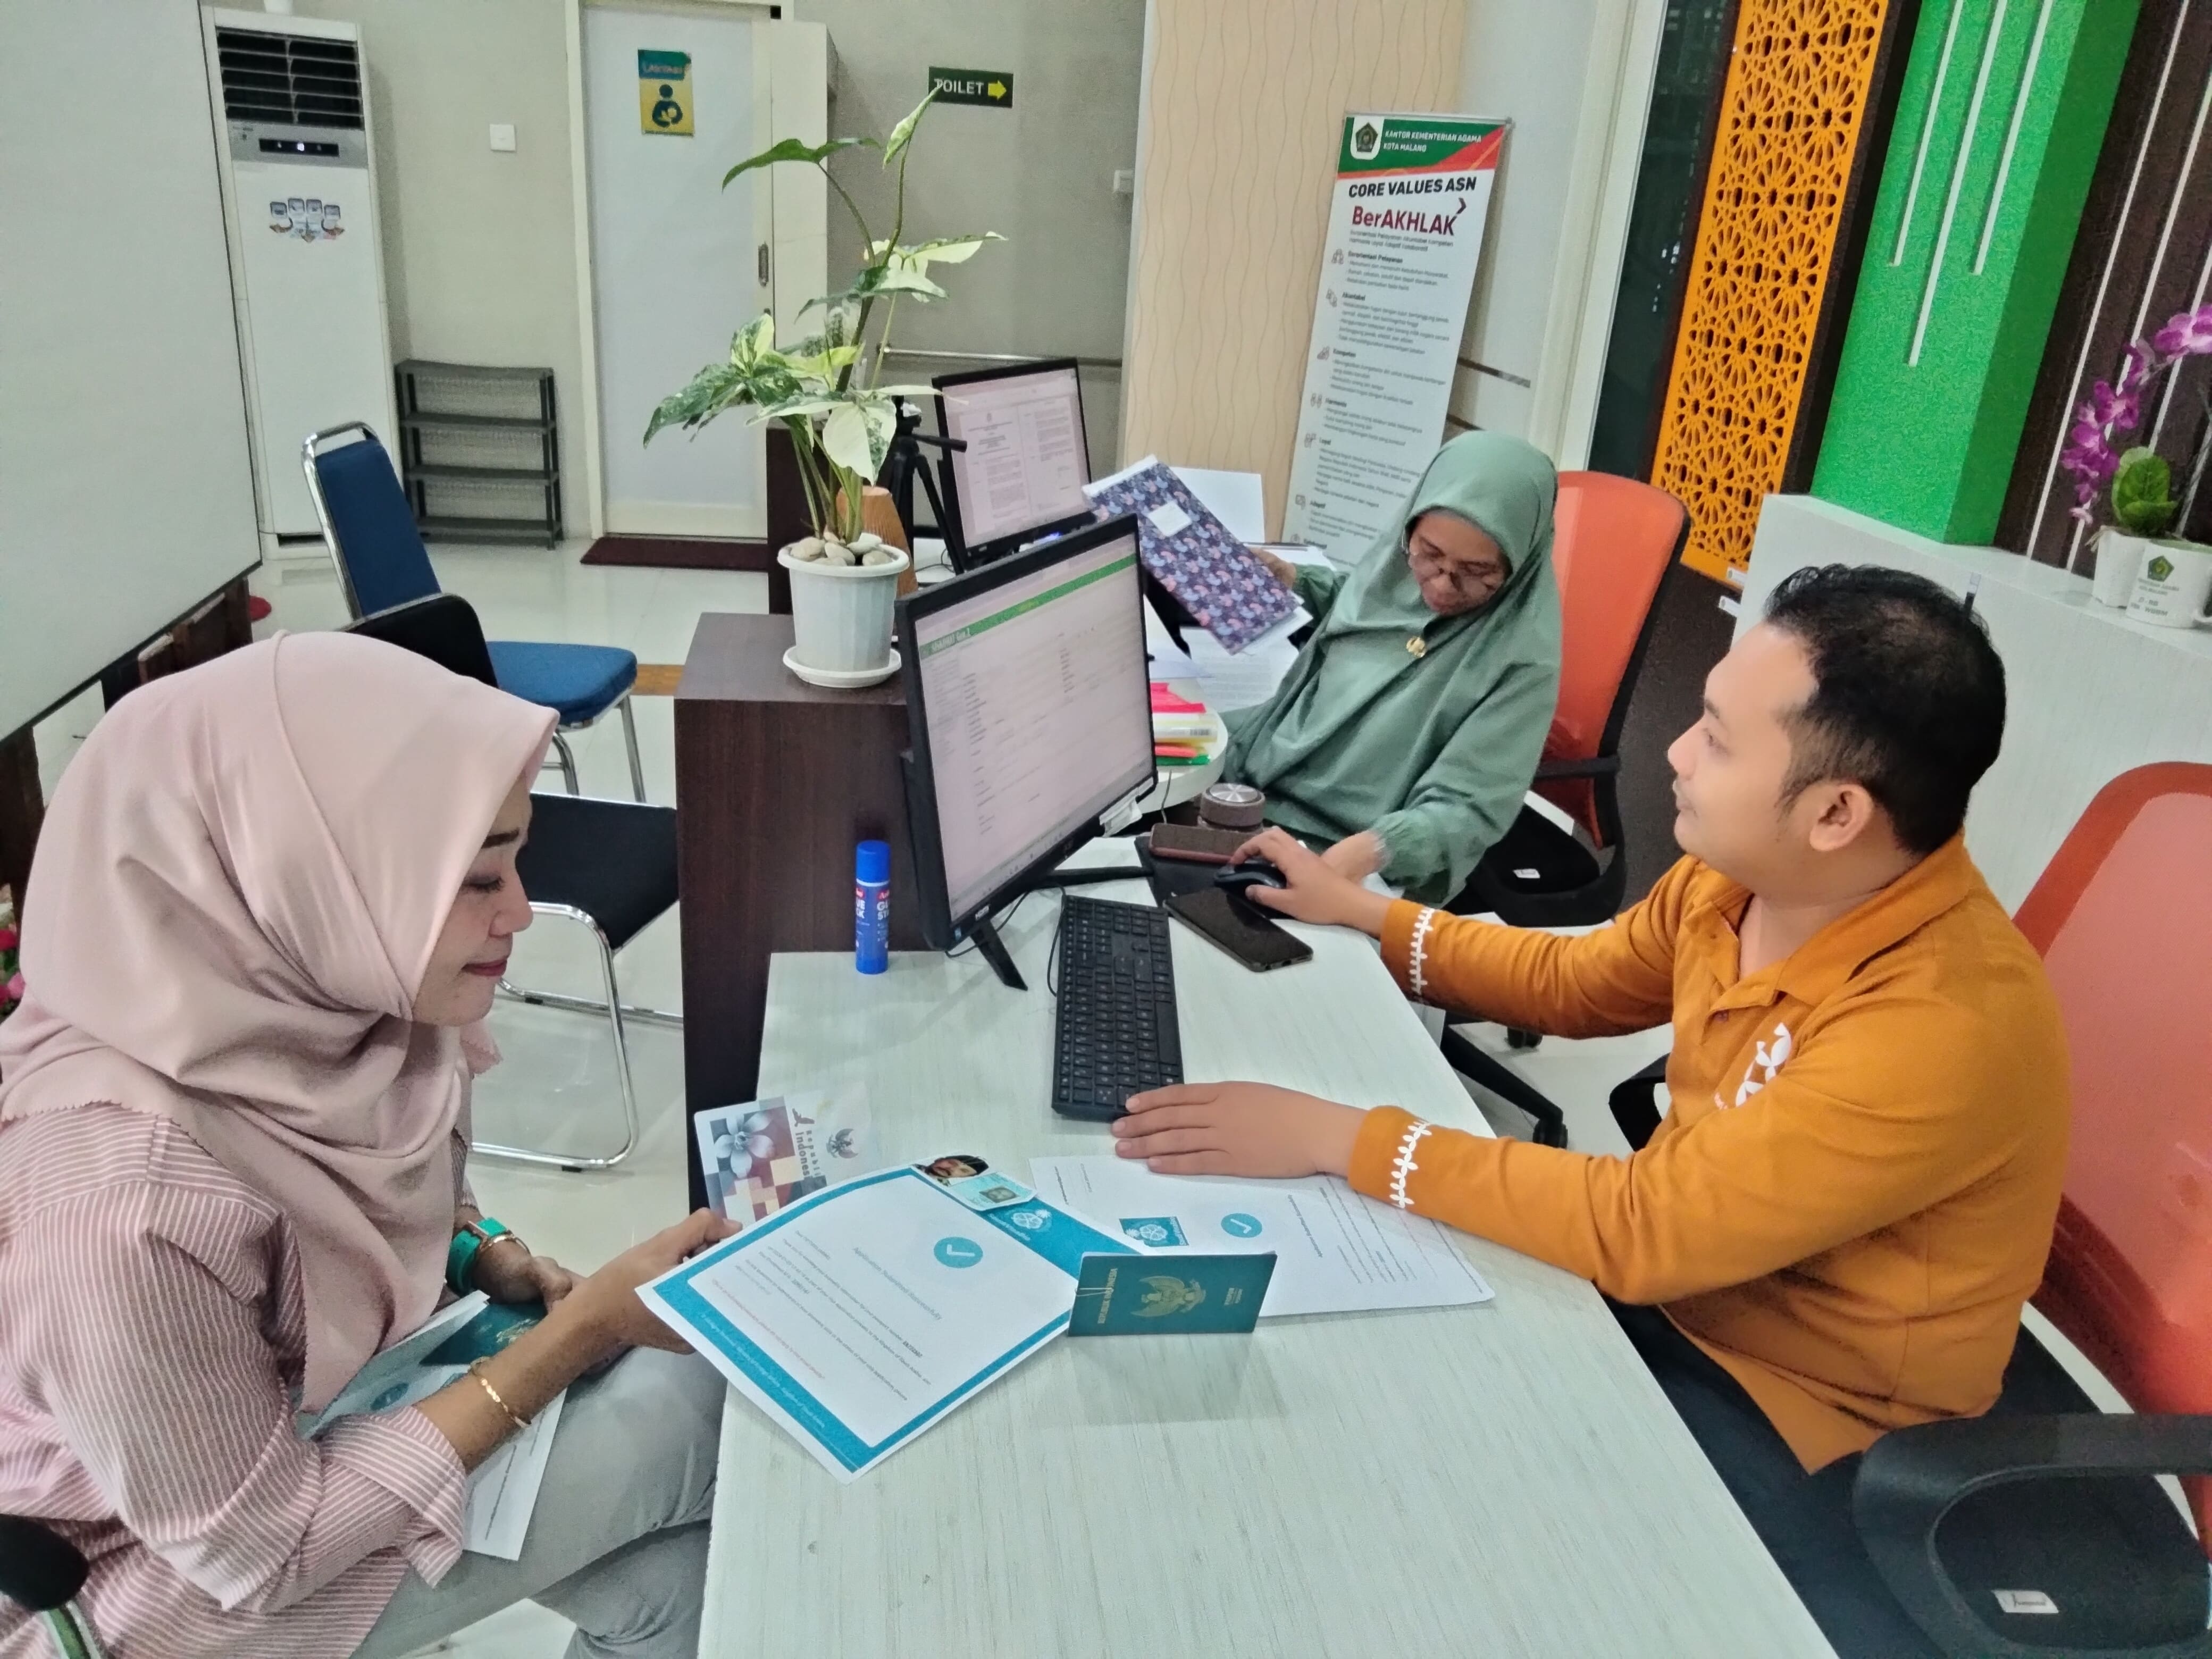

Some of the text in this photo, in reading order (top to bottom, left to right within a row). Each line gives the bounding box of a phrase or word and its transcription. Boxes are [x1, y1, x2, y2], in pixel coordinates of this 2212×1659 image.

[934, 78, 984, 95] TOILET
[1385, 130, 1410, 139] KANTOR
[1411, 131, 1457, 142] KEMENTERIAN
[1348, 176, 1477, 198] CORE VALUES ASN
[1352, 205, 1458, 236] BerAKHLAK
[806, 1130, 821, 1176] Republi
